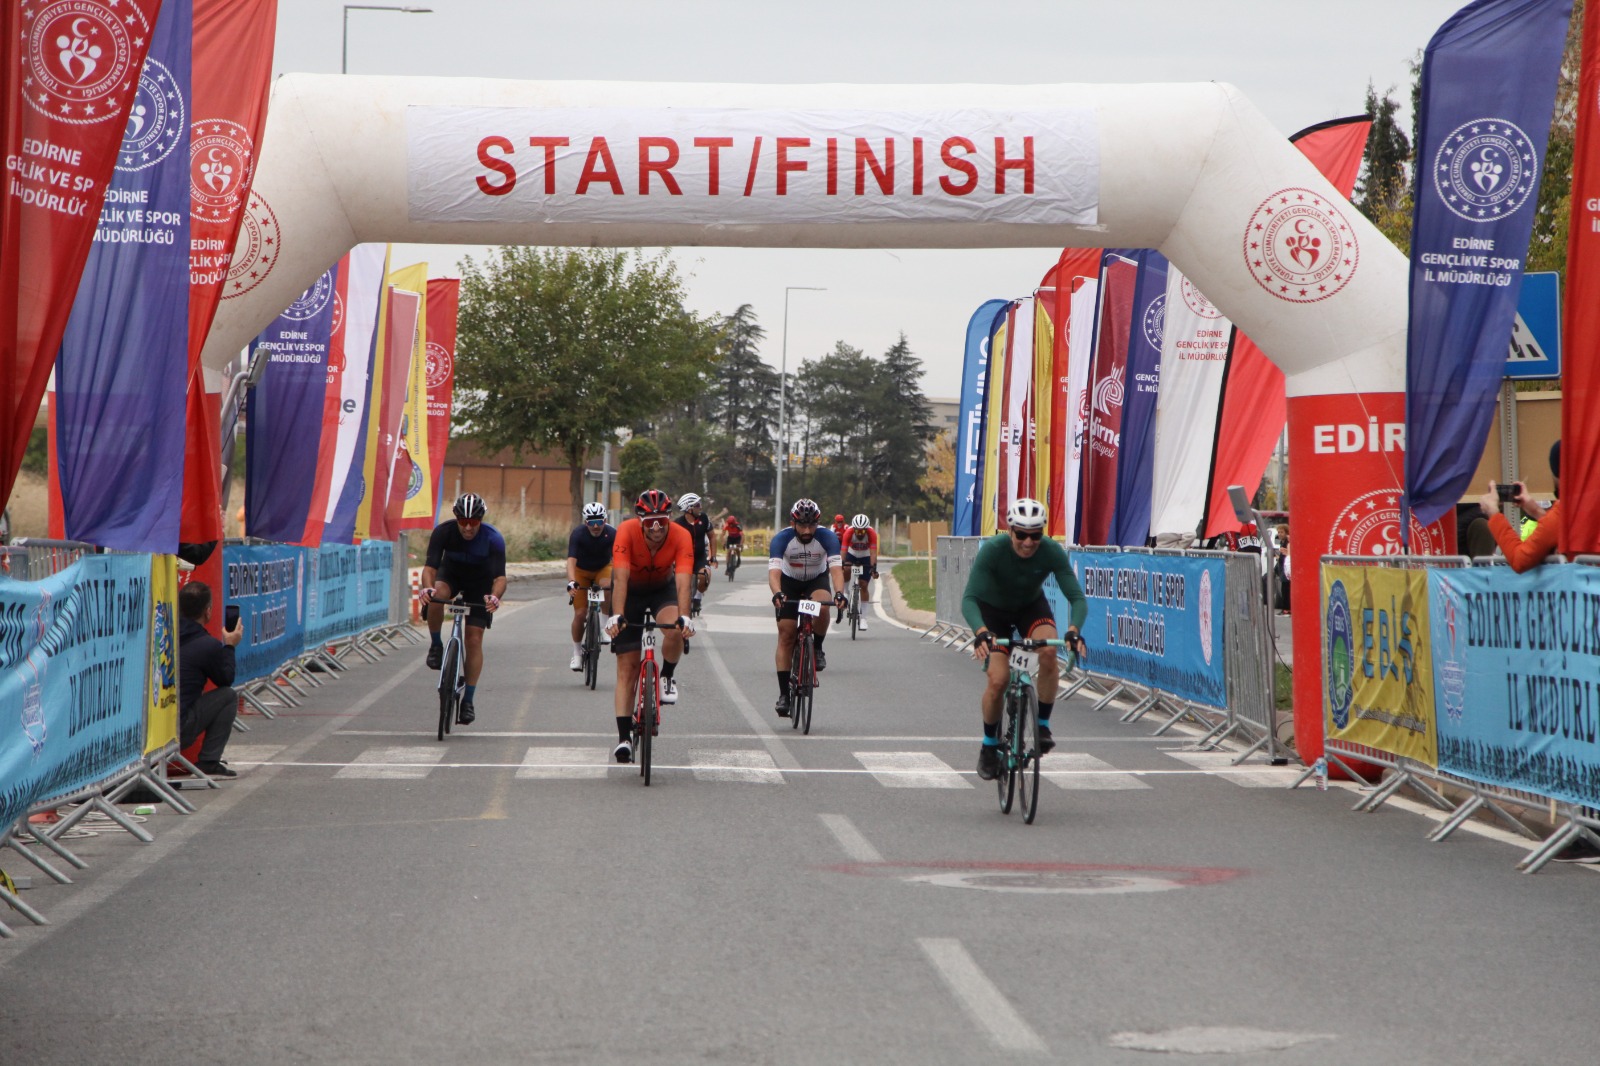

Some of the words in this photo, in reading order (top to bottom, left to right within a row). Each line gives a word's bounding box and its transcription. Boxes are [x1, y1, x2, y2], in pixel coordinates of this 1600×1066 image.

[74, 2, 113, 24] GENÇLİK
[32, 2, 72, 52] CUMHURİYETİ
[111, 23, 122, 36] VE
[118, 37, 126, 62] SPOR
[33, 55, 58, 90] TÜRKİYE
[82, 64, 124, 97] BAKANLIĞI
[22, 138, 82, 166] EDİRNE
[475, 135, 1035, 197] START/FINISH
[49, 169, 71, 188] VE
[127, 210, 143, 222] VE
[146, 211, 180, 226] SPOR
[248, 222, 258, 242] SPOR
[1266, 210, 1292, 256] CUMHURİYETİ
[1453, 237, 1494, 250] EDİRNE
[1421, 253, 1472, 268] GENÇLİK
[1472, 256, 1488, 267] VE
[1489, 258, 1520, 270] SPOR
[1425, 268, 1436, 282] İL
[1438, 270, 1512, 286] MÜDÜRLÜĞÜ
[280, 330, 308, 340] EDİRNE
[1196, 329, 1223, 338] EDİRNE
[259, 342, 294, 352] GENÇLİK
[1176, 341, 1208, 350] GENÇLİK
[271, 354, 322, 364] MÜDÜRLÜĞÜ
[1179, 351, 1186, 360] İL
[1314, 416, 1406, 454] EDİR
[228, 554, 258, 598] EDİRNE
[1084, 560, 1114, 600] EDİRNE
[1116, 562, 1148, 610] GENÇLİK
[1152, 572, 1163, 607] VE
[1166, 573, 1185, 610] SPOR
[800, 602, 816, 612] 180
[1118, 607, 1165, 657] MÜDÜRLÜĞÜ
[1012, 654, 1029, 668] 141
